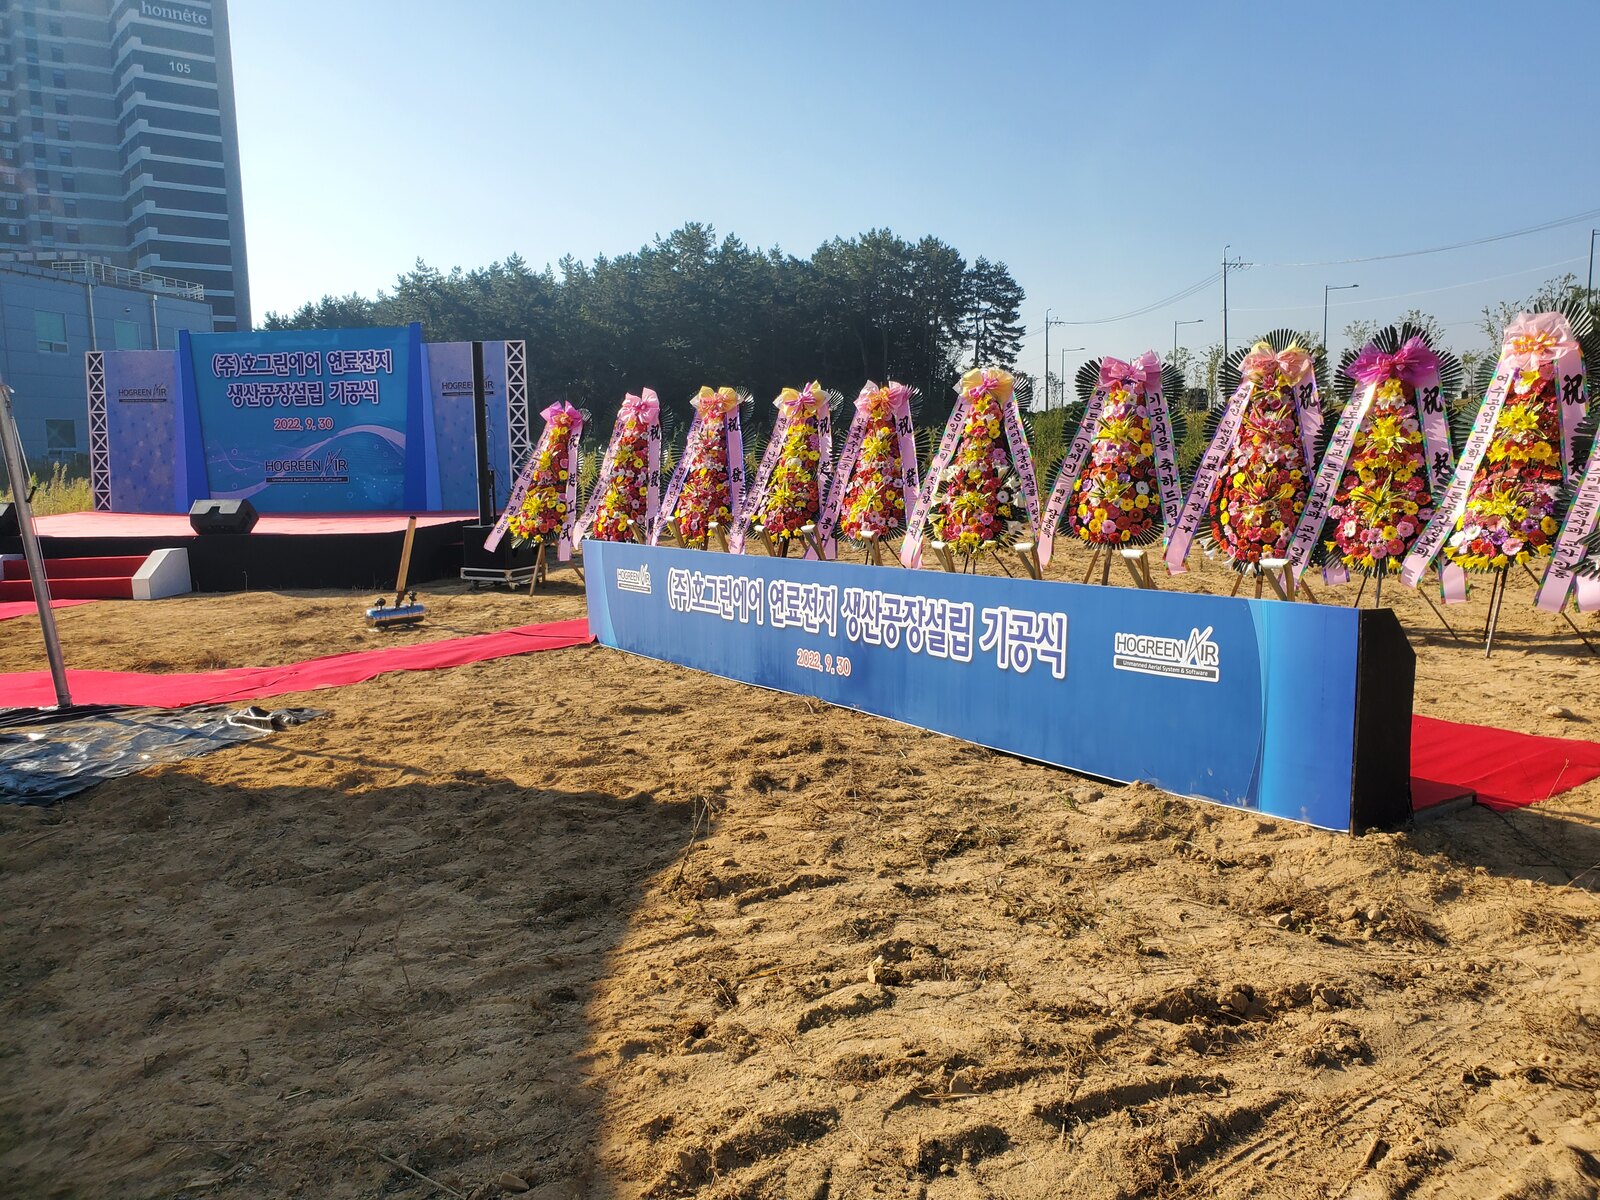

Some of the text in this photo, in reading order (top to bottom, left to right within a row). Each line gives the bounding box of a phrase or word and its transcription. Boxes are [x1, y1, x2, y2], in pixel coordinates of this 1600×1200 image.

[141, 0, 208, 25] honnête
[168, 60, 191, 74] 105
[212, 348, 393, 378] (주)호그린에어 연료전지
[227, 379, 380, 408] 생산공장설립 기공식
[273, 417, 303, 431] 2022.
[317, 416, 334, 430] 30
[1149, 393, 1170, 451] 기공식을
[667, 567, 1068, 680] (주)호그린에어 연료전지 생산공장설립 기공식
[796, 648, 824, 671] 2022.
[836, 657, 851, 677] 30
[1122, 660, 1148, 669] Unmanned
[1162, 666, 1180, 674] System
[1185, 669, 1209, 677] Software
